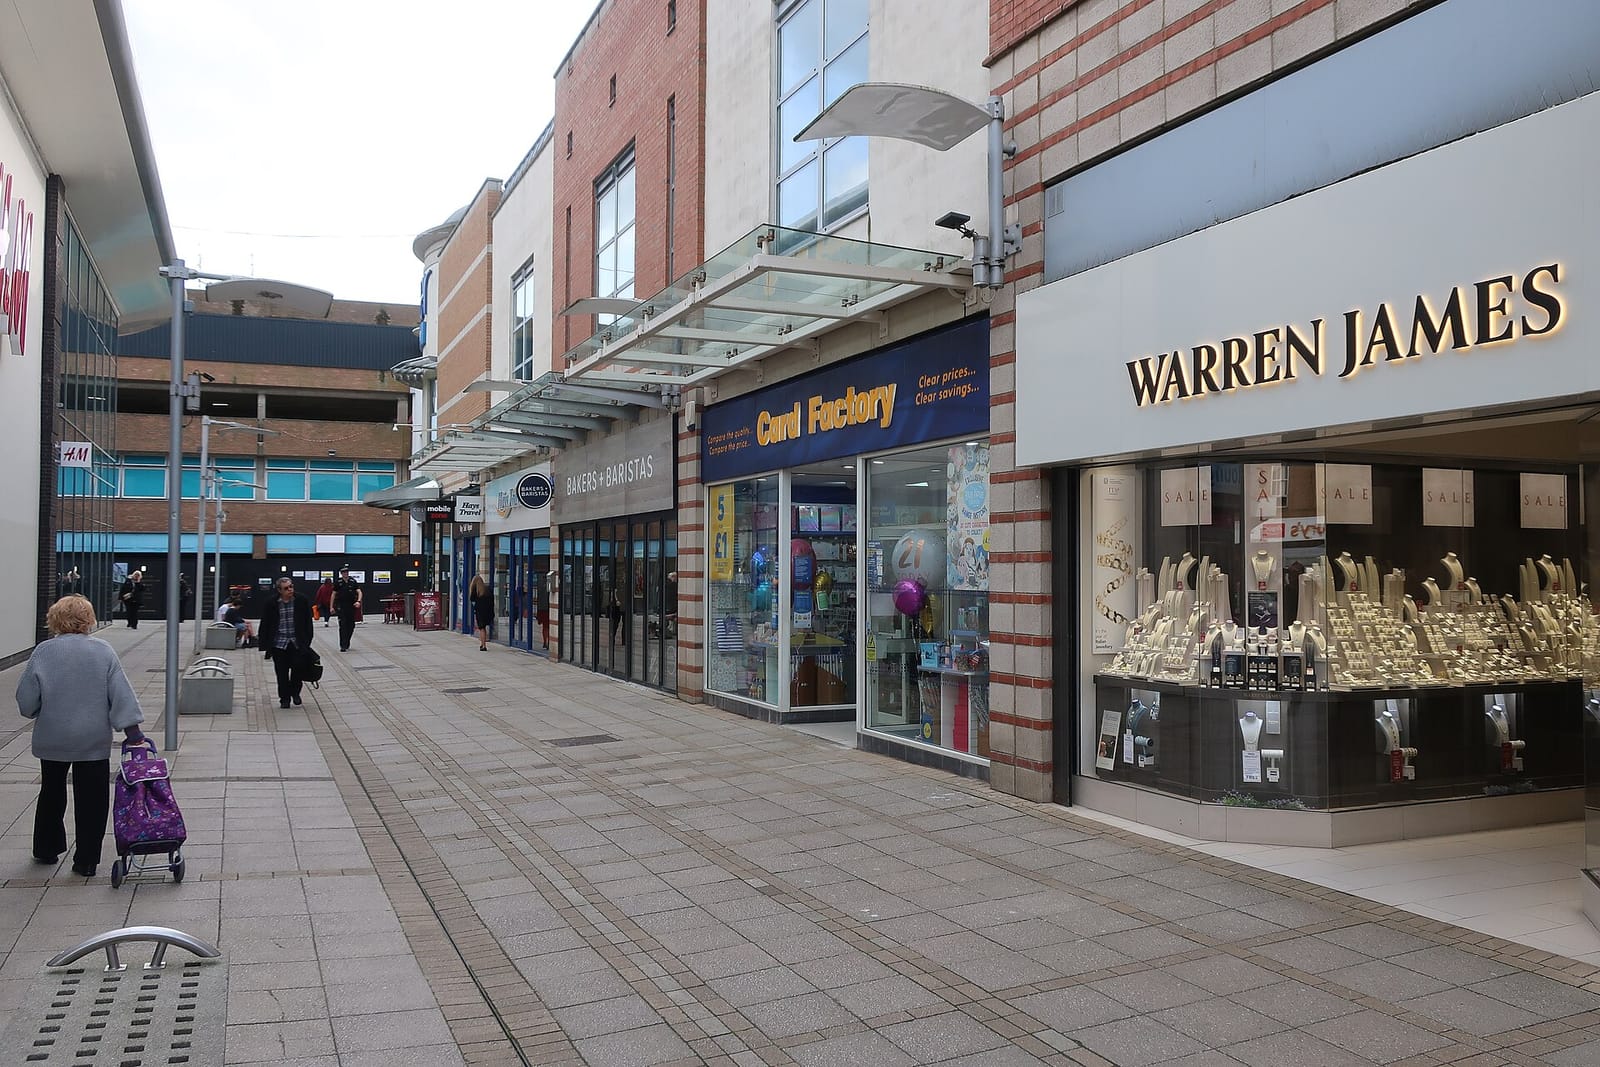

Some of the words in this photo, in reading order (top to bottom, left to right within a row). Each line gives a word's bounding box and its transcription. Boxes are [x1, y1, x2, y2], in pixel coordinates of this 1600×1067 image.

[1125, 317, 1323, 408] WARREN
[1338, 263, 1563, 379] JAMES
[918, 374, 940, 389] Clear
[942, 366, 976, 384] prices...
[915, 389, 937, 406] Clear
[938, 382, 980, 401] savings...
[757, 402, 801, 446] Card
[808, 382, 897, 435] Factory
[566, 470, 597, 496] BAKERS
[599, 471, 604, 486] +
[606, 454, 653, 488] BARISTAS
[1164, 489, 1208, 504] SALE
[1320, 487, 1369, 500] SALE
[1427, 491, 1472, 504] SALE
[1524, 494, 1566, 507] SALE
[427, 505, 451, 513] mobile
[459, 508, 482, 516] Travel
[461, 501, 480, 511] Hays
[717, 495, 725, 522] 5
[715, 531, 727, 559] £1
[898, 537, 925, 569] 21
